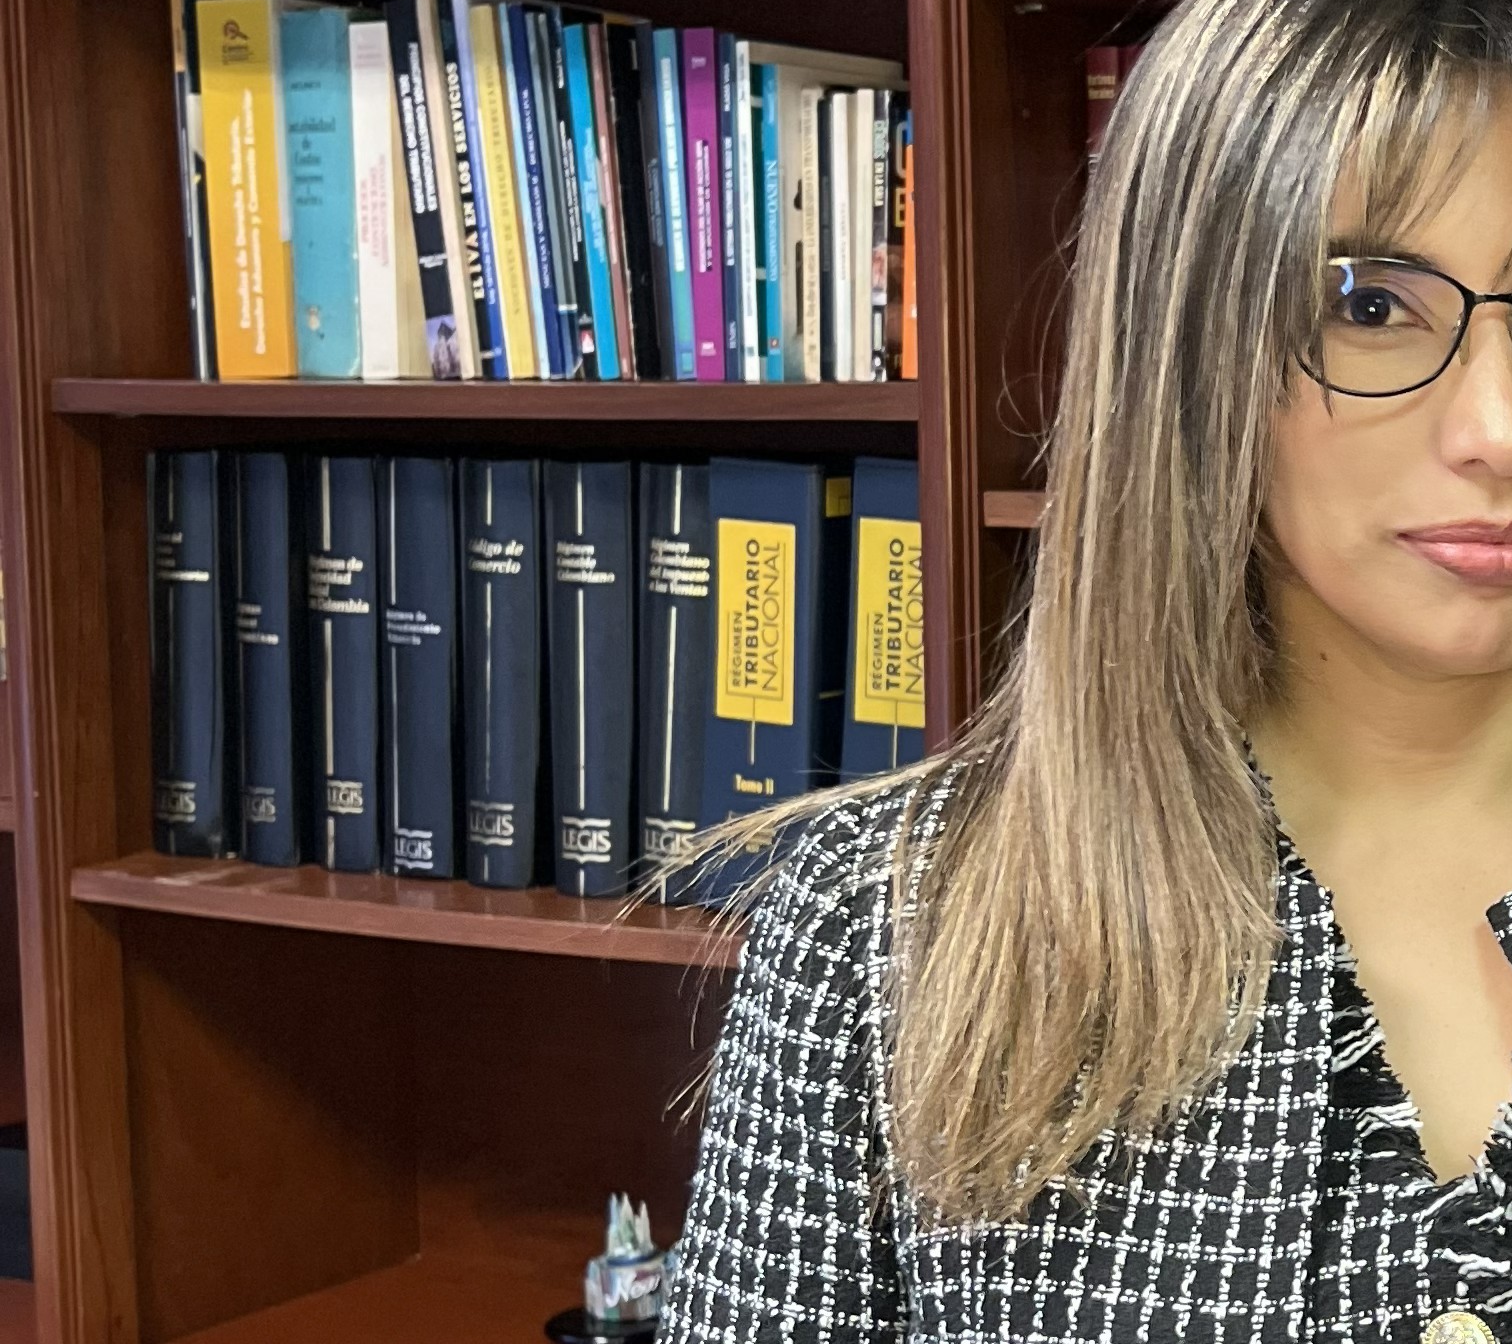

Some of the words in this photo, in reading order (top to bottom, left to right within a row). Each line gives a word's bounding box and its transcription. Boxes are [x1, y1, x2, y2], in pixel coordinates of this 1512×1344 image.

[446, 62, 468, 154] SERVICIOS
[458, 161, 472, 194] LOS
[463, 202, 476, 228] EN
[465, 231, 483, 276] IVA
[471, 277, 485, 299] EL
[745, 539, 760, 688] TRIBUTARIO
[761, 541, 782, 693] NACIONAL
[885, 538, 905, 692] TRIBUTARIO
[904, 544, 925, 696] NACIONAL
[731, 612, 744, 688] RÉGIMEN
[871, 613, 884, 691] RÉGIMEN
[327, 786, 364, 808] LEGIS
[732, 773, 763, 794] Tomo
[765, 777, 774, 796] II
[470, 809, 514, 837] LEGIS
[394, 838, 433, 859] LEGIS
[563, 828, 611, 854] LEGIS
[645, 828, 695, 857] LEGIS
